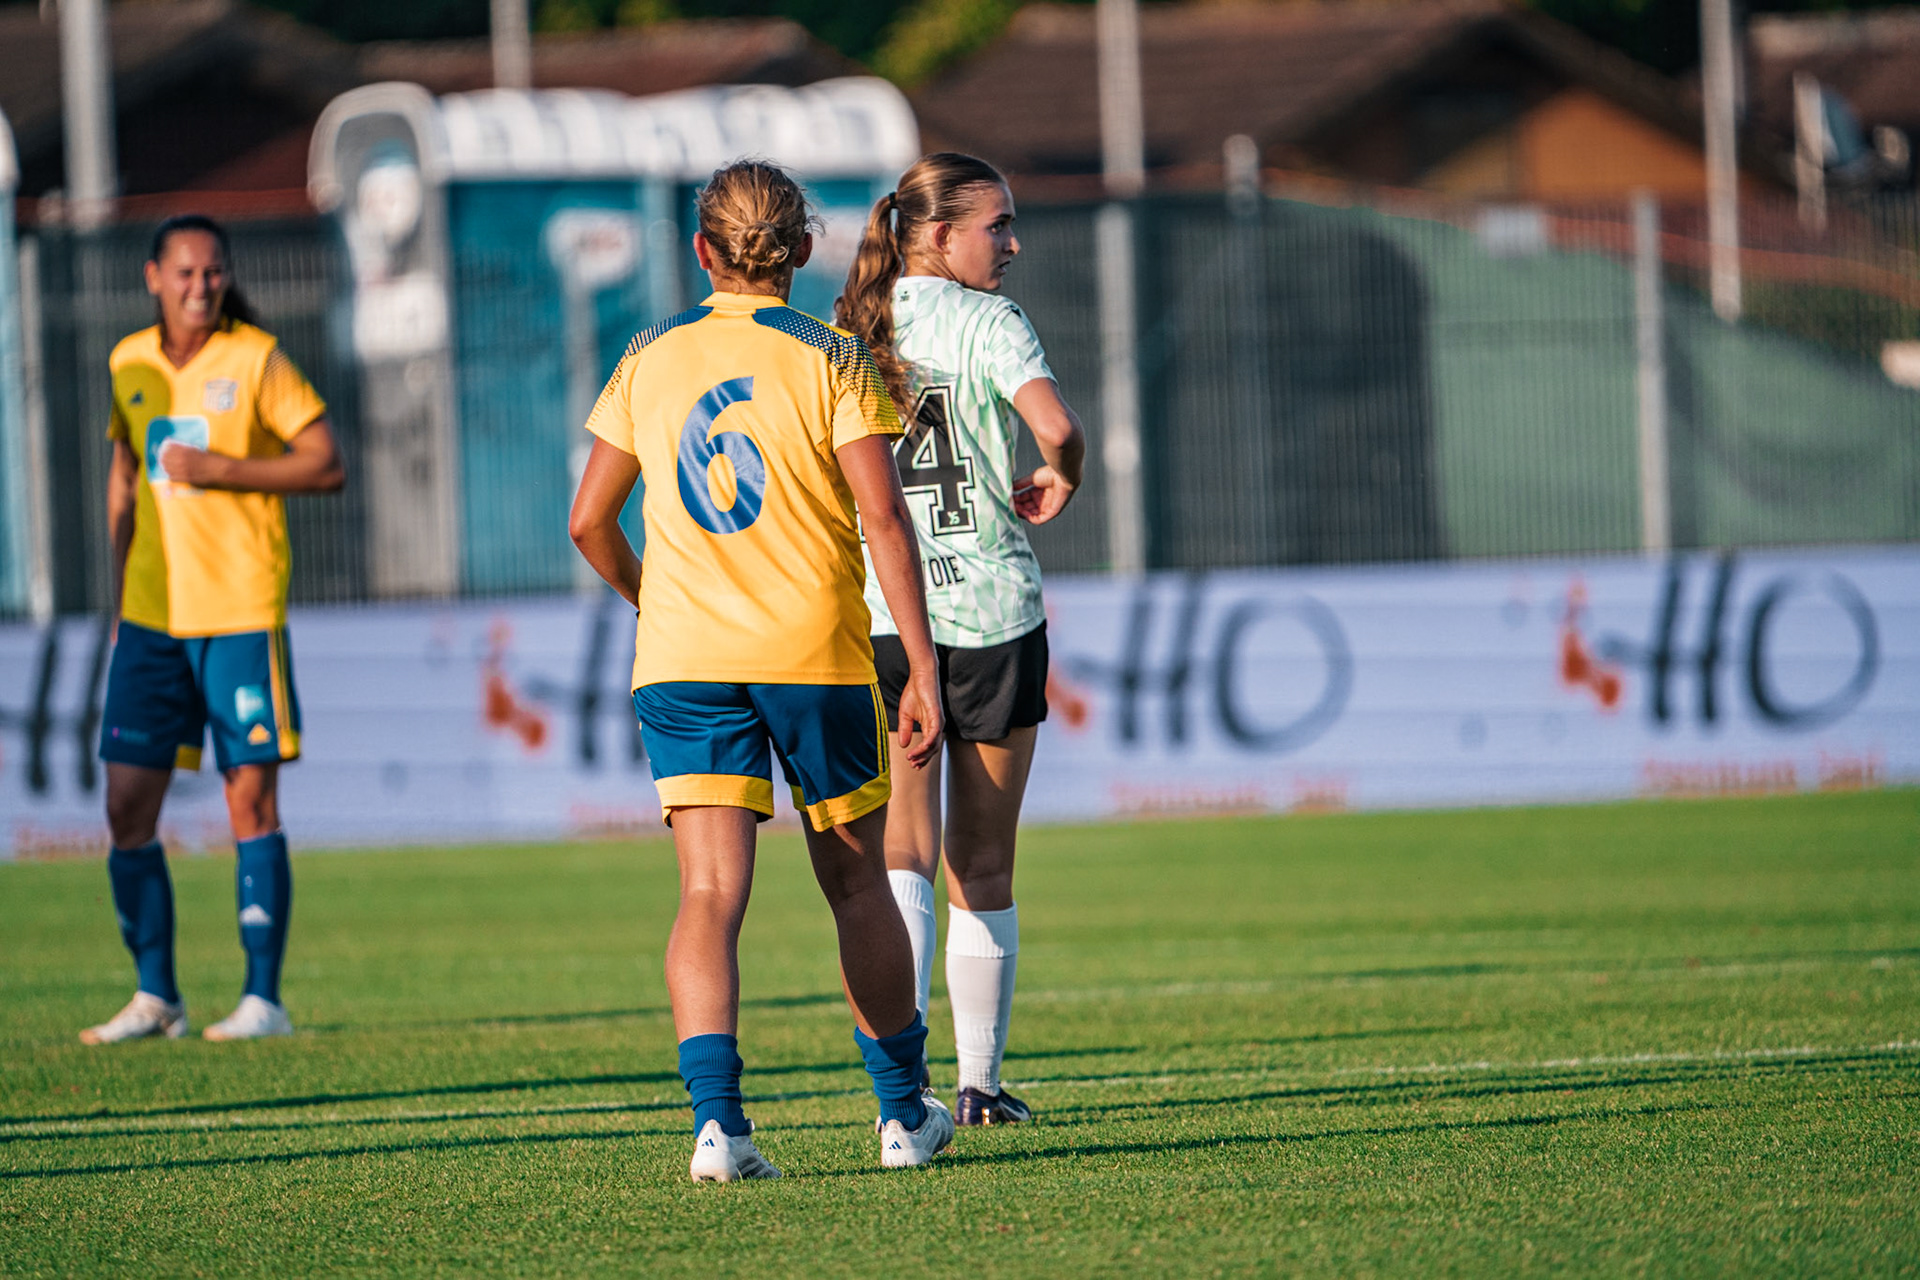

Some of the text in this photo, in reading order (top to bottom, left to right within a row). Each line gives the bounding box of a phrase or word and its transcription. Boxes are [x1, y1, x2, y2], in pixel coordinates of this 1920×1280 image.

[677, 376, 765, 535] 6
[856, 386, 977, 544] 4
[922, 555, 965, 589] OIE
